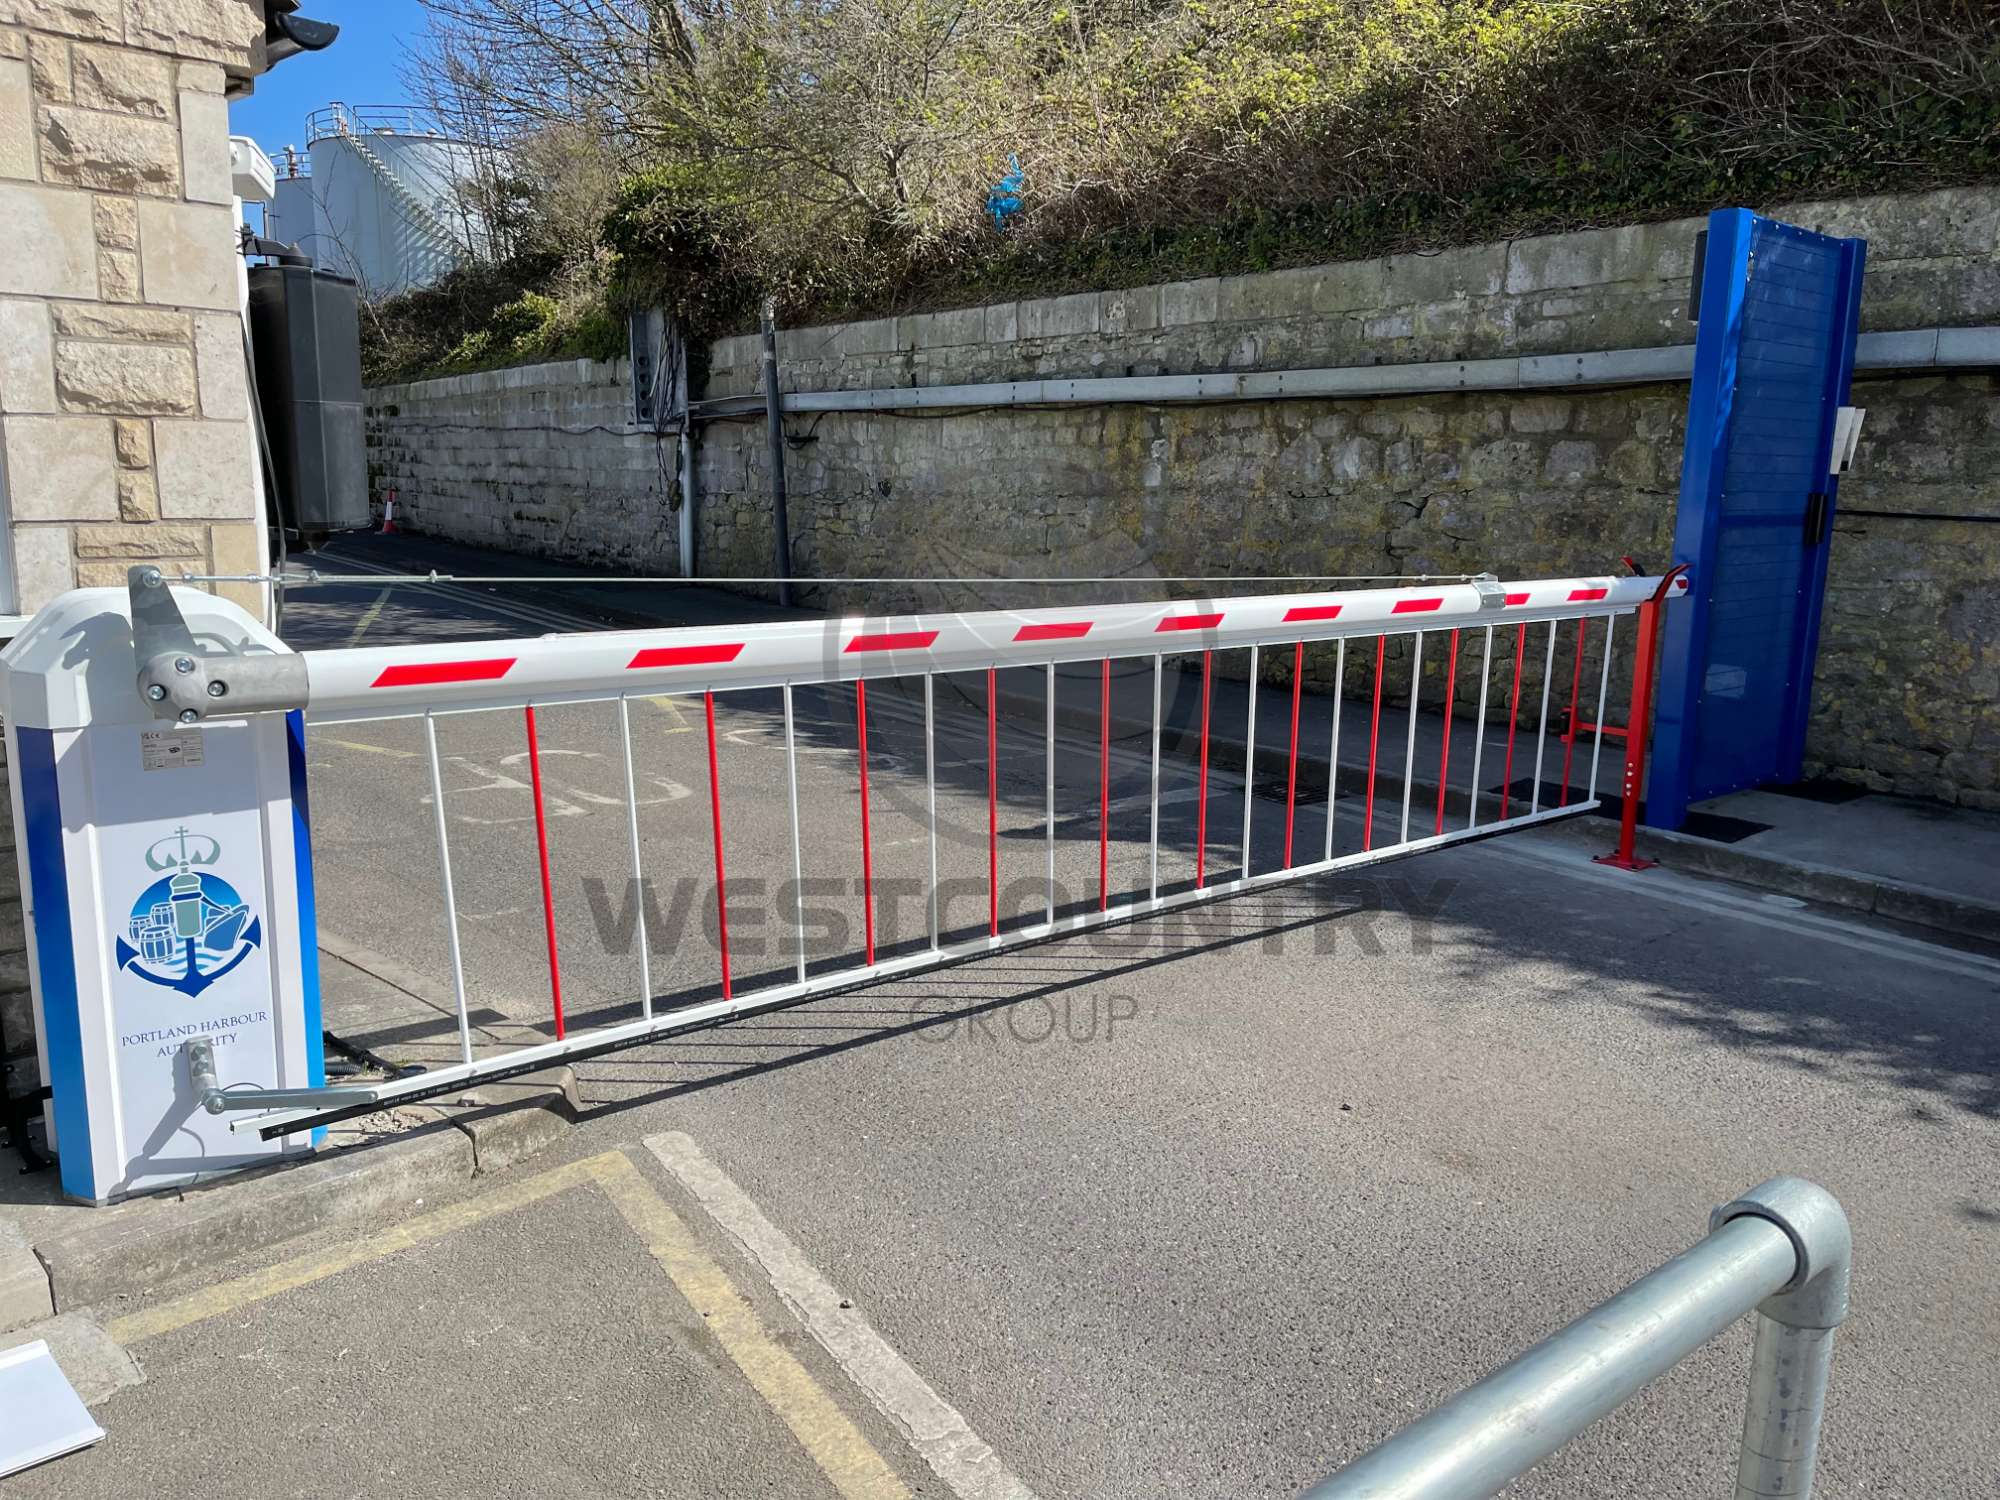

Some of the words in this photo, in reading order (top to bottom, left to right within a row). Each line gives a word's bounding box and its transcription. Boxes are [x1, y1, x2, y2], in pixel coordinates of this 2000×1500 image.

[121, 1024, 197, 1047] PORTLAND
[200, 1011, 268, 1033] HARBOUR
[157, 1033, 238, 1057] AUTITY
